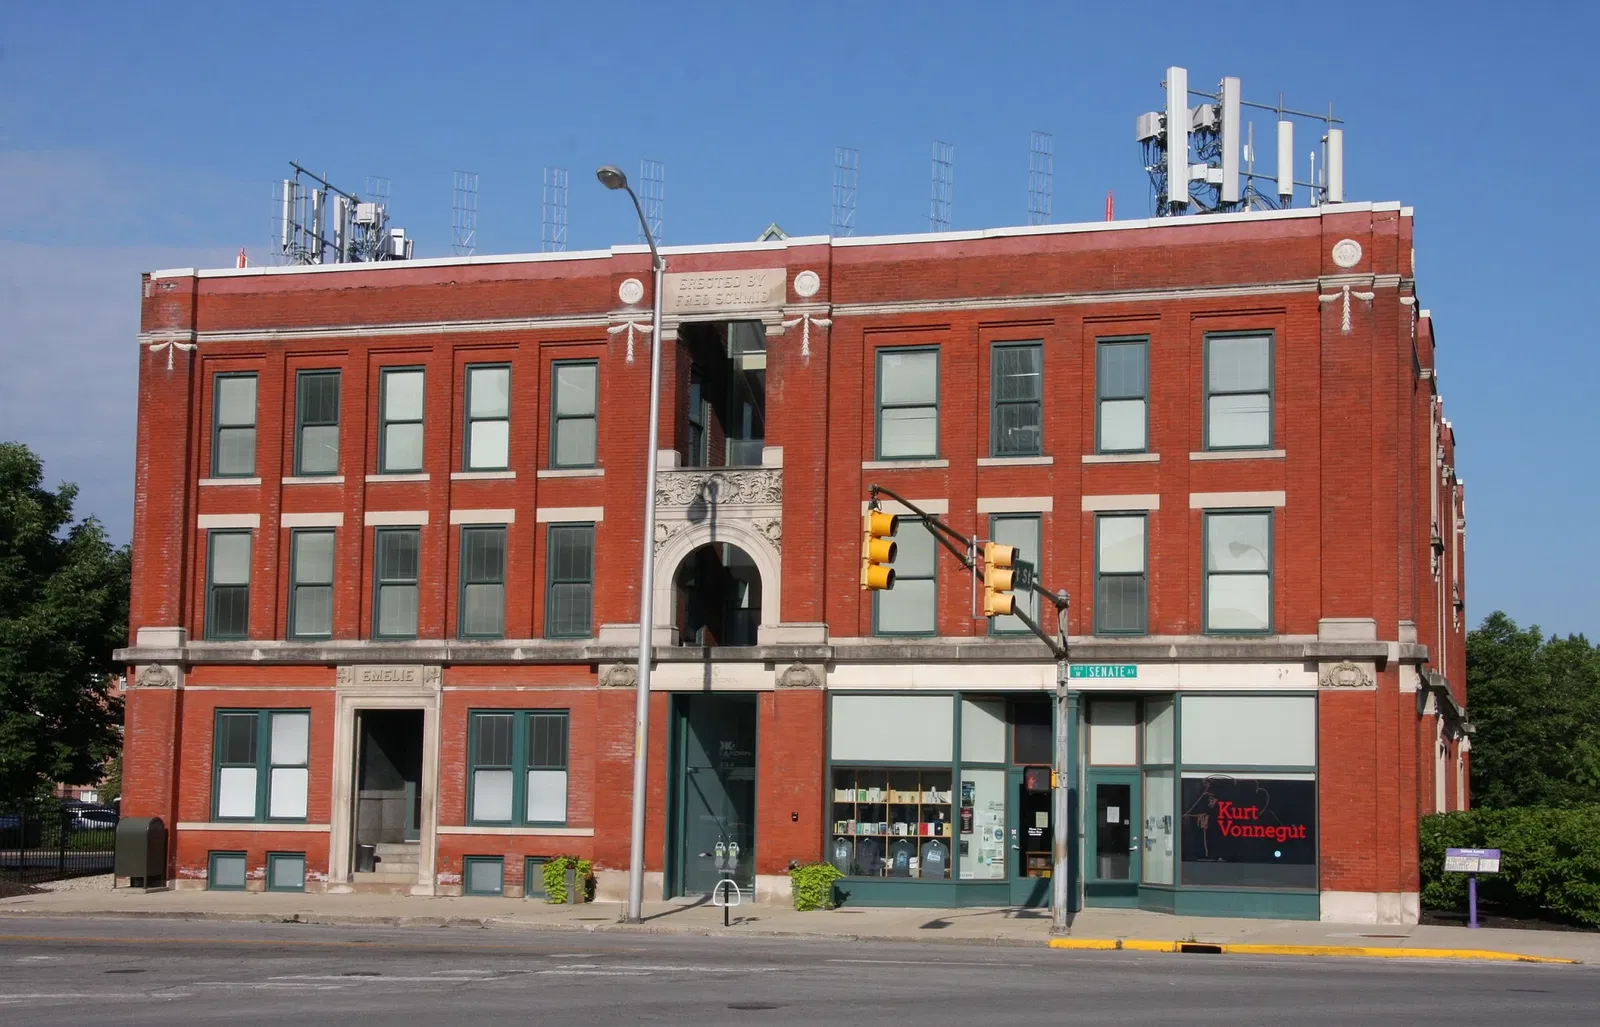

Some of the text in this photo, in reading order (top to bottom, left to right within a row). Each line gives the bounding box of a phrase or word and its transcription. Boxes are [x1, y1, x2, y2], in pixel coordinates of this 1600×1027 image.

[679, 274, 766, 291] ERECTED BY
[675, 291, 769, 307] FRED SCHMID
[362, 669, 415, 682] EMELIE
[1089, 666, 1125, 677] SENATE
[1218, 802, 1258, 820] Kurt
[1218, 820, 1306, 842] Vonnegut
